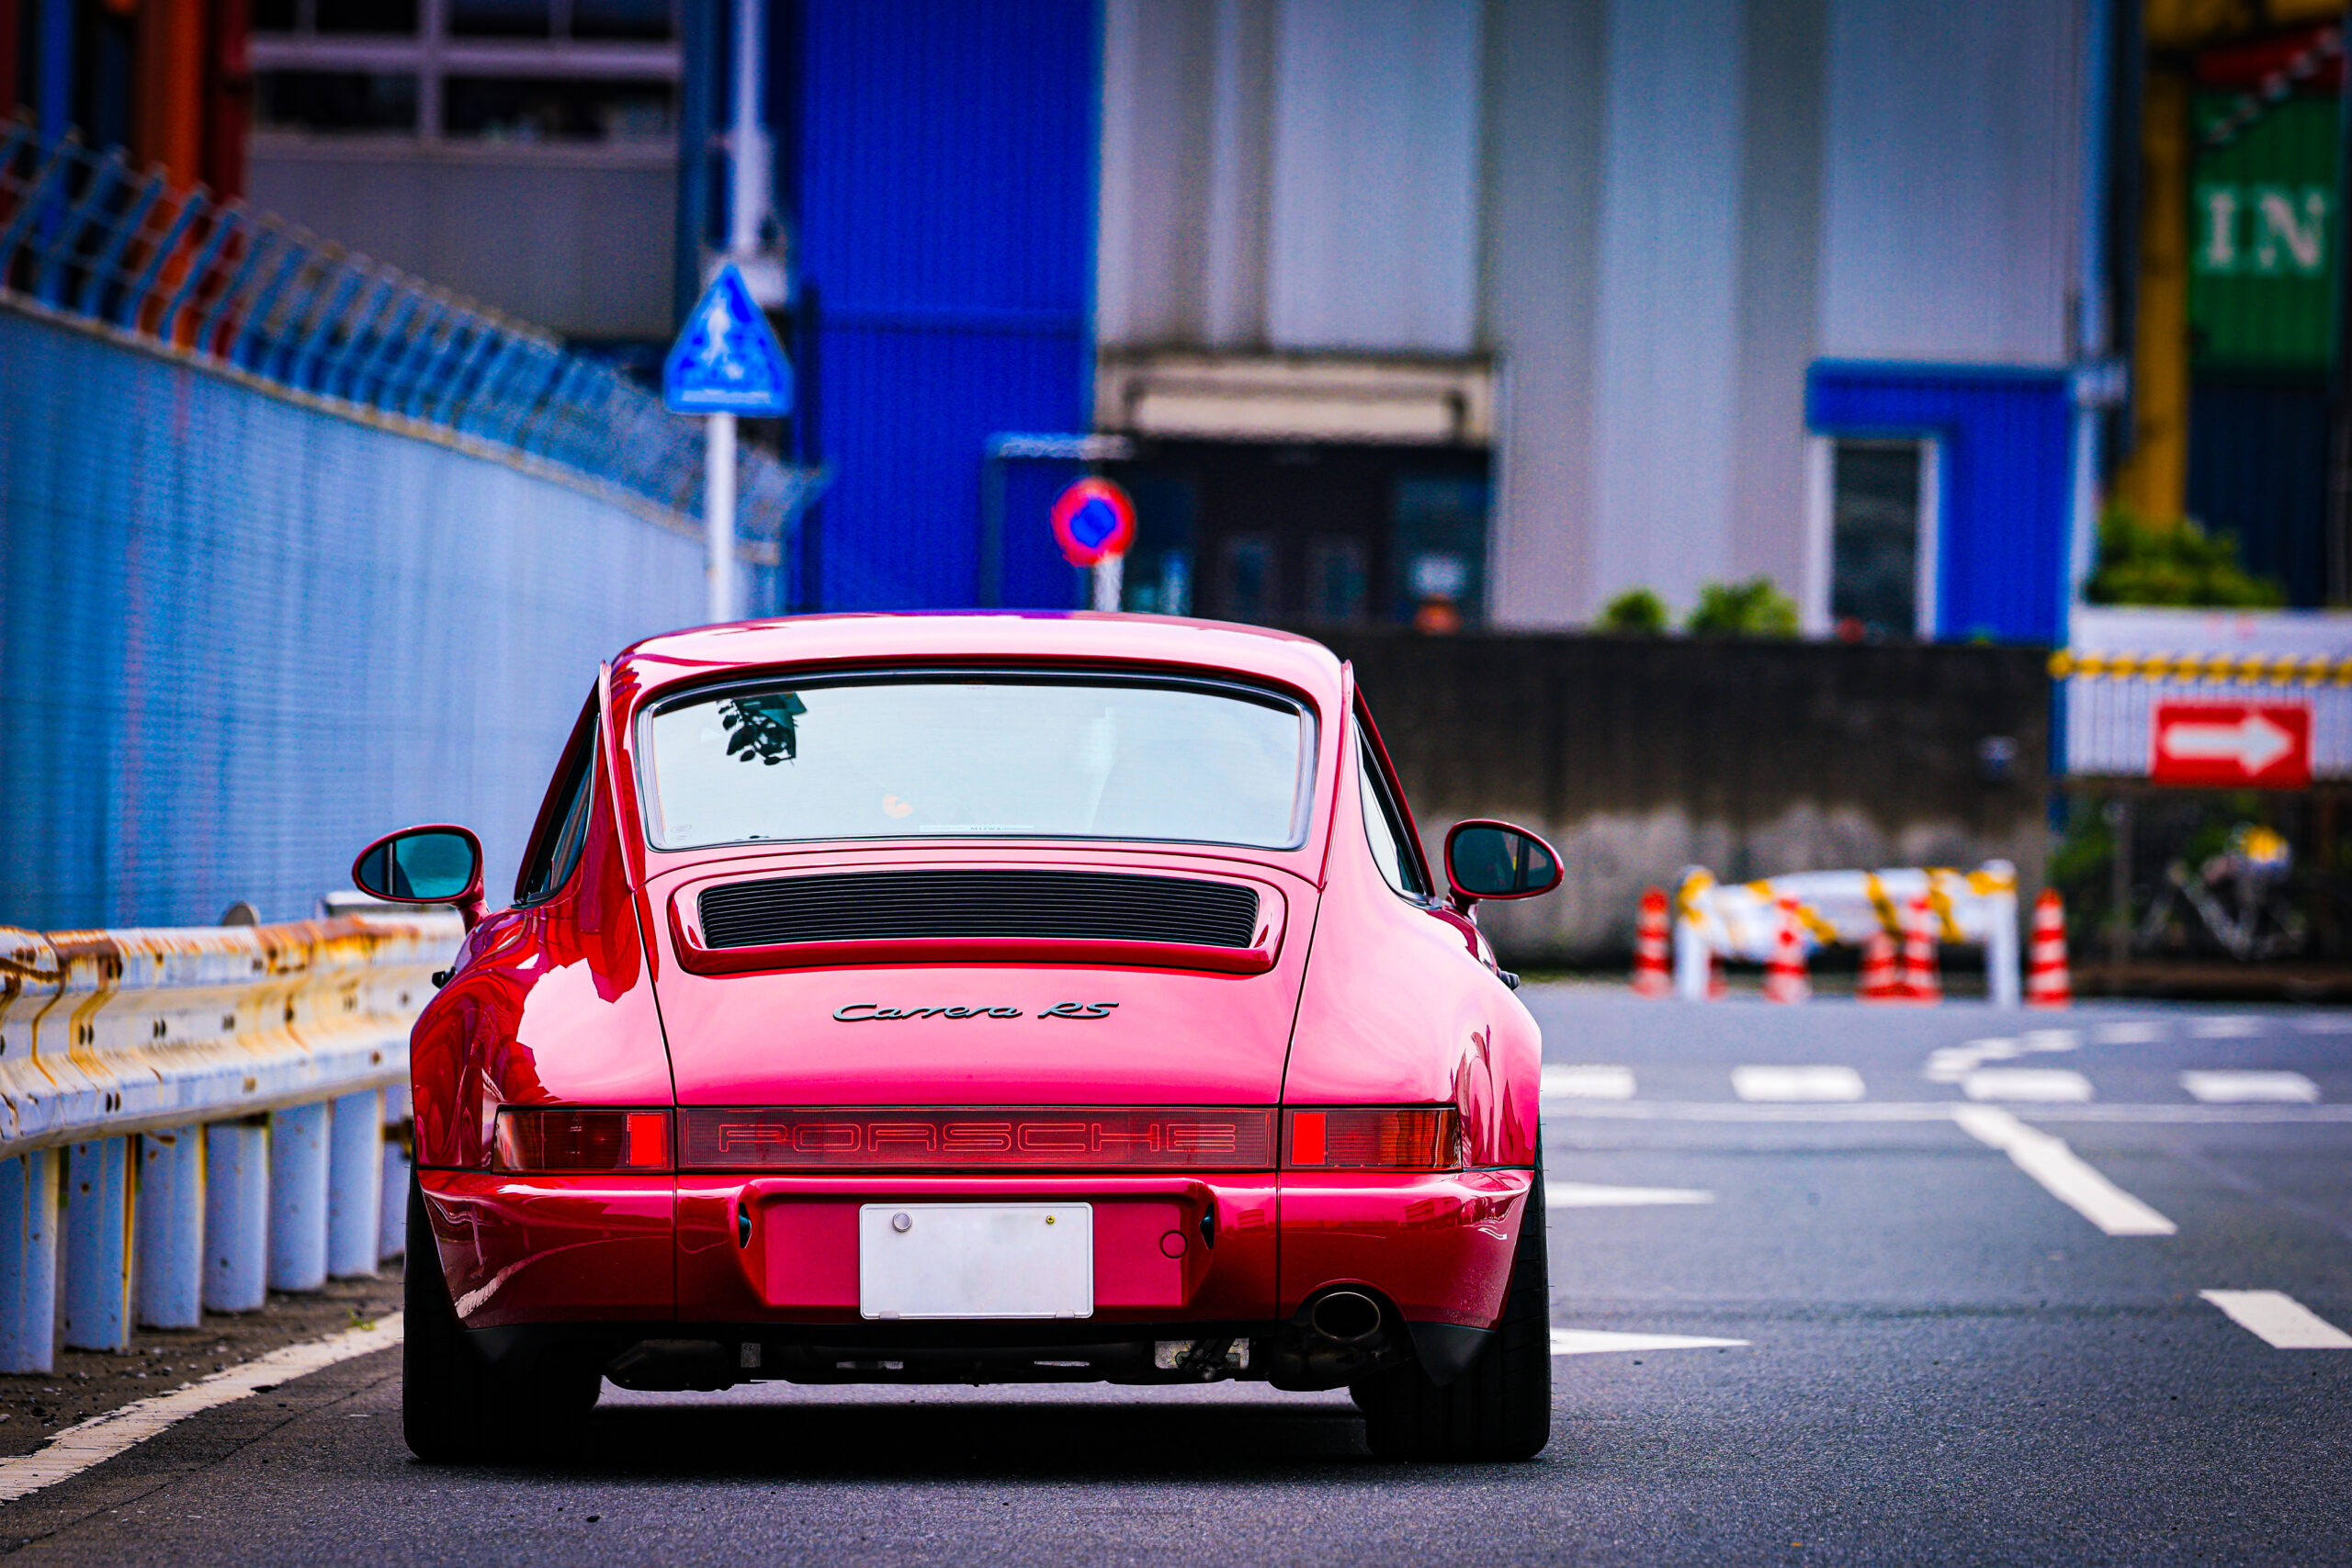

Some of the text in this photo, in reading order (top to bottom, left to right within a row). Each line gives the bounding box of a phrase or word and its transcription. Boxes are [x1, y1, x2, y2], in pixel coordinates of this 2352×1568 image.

[832, 1001, 1120, 1023] Carrera RS
[718, 1122, 1236, 1153] PORSCHE
